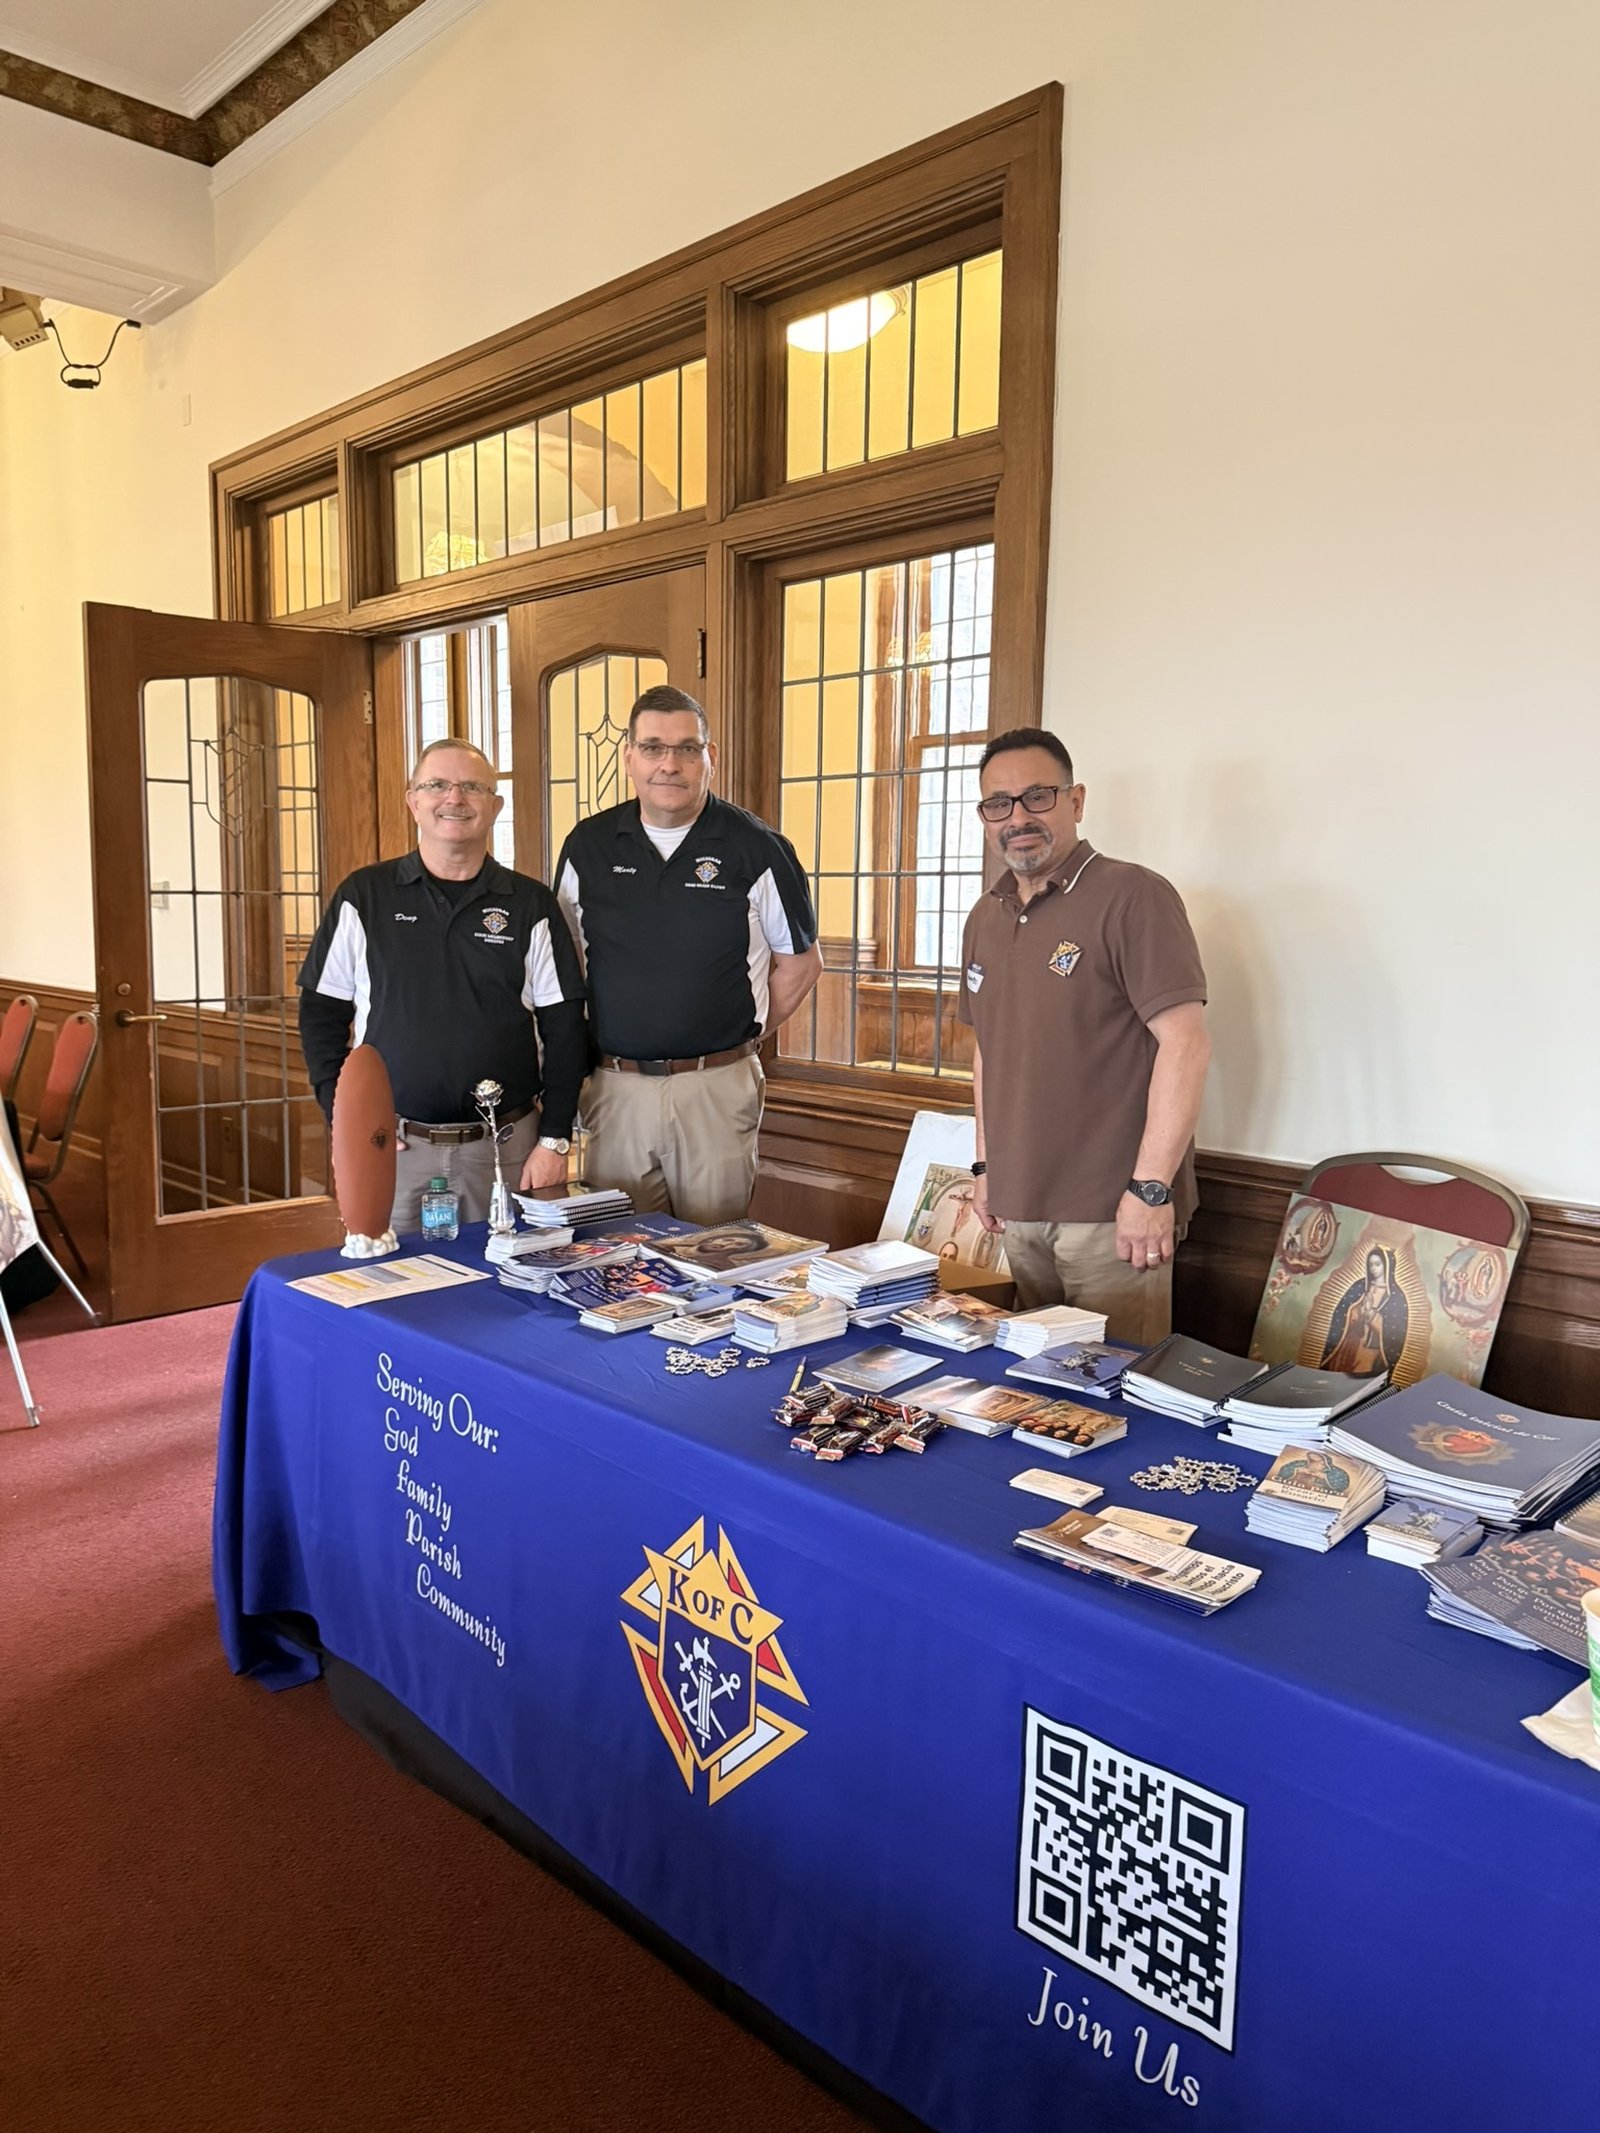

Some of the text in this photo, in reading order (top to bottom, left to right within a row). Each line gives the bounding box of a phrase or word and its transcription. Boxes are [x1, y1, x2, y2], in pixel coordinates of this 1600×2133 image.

[425, 1211, 452, 1222] DASANI
[377, 1353, 499, 1453] Serving Our:
[384, 1407, 420, 1456] God
[406, 1509, 462, 1580] Parish
[1211, 1564, 1236, 1581] hacia
[417, 1563, 506, 1668] Community
[1027, 1967, 1200, 2107] Join Us
